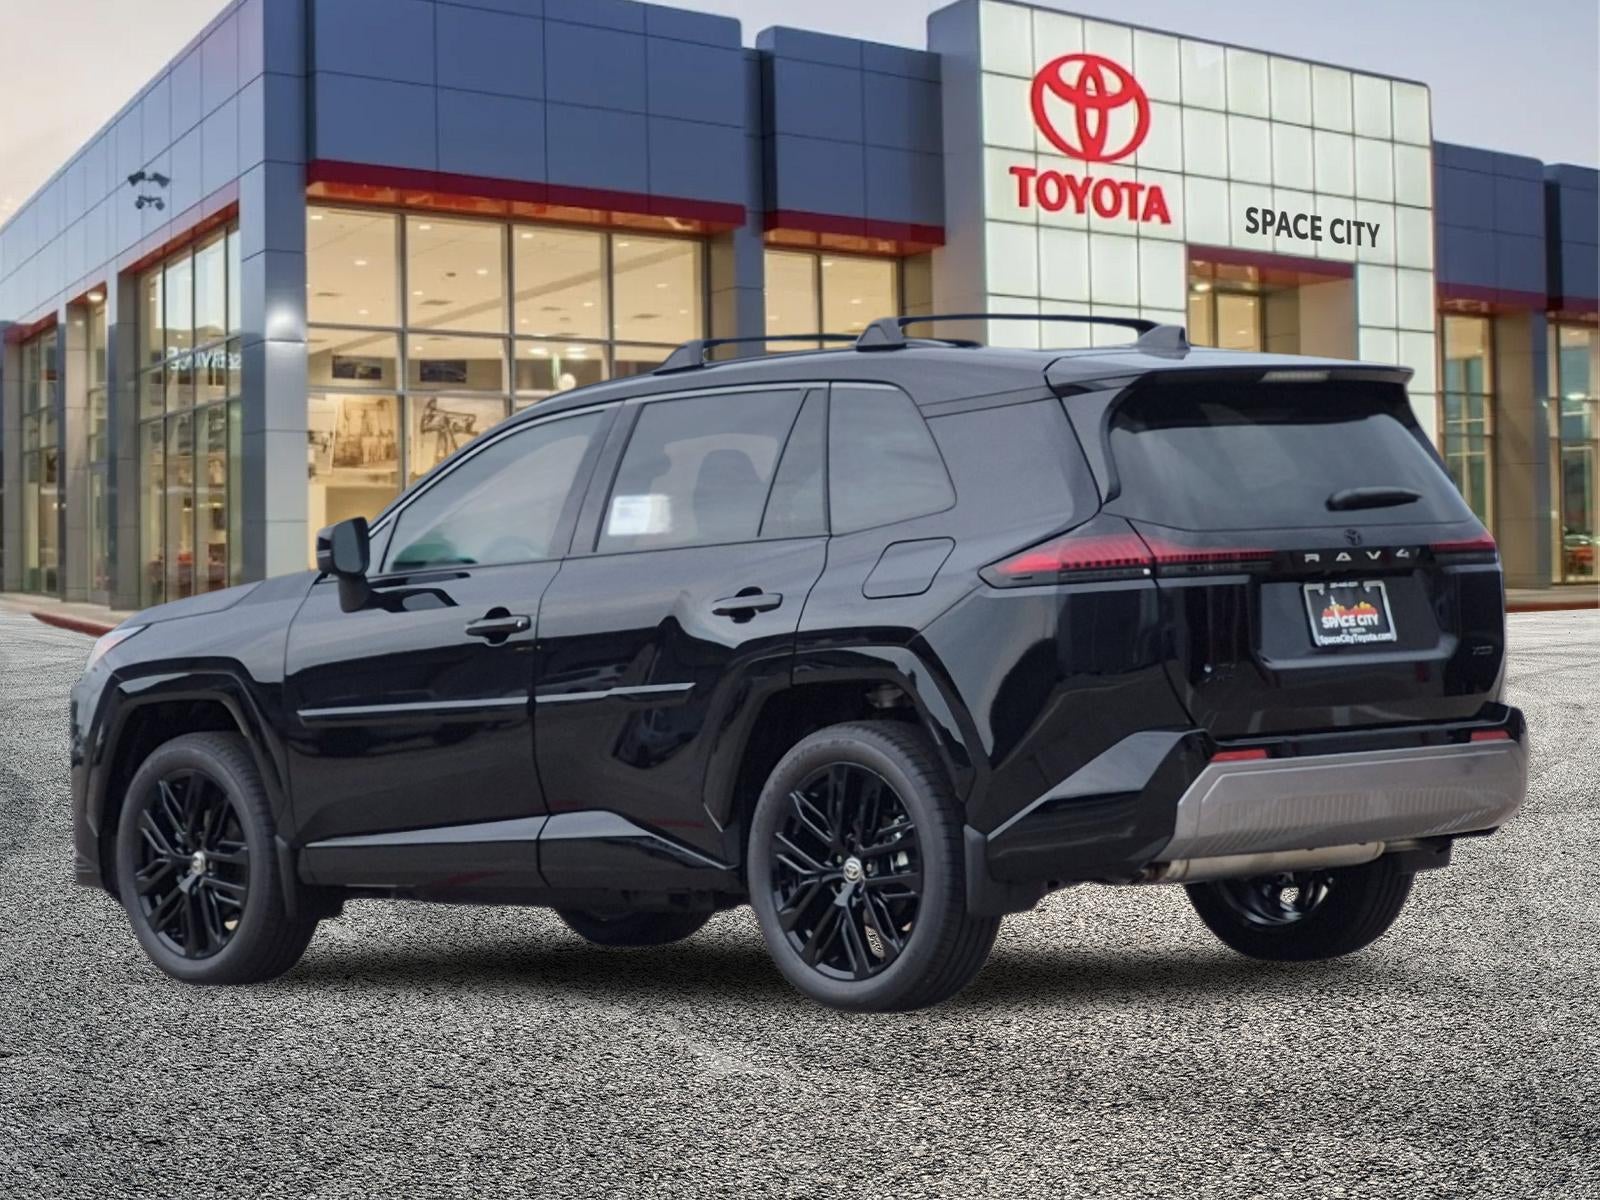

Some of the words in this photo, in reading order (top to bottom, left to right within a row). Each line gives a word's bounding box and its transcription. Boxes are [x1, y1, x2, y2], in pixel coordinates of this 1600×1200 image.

[1010, 167, 1170, 223] TOYOTA
[1246, 207, 1321, 241] SPACE
[1330, 219, 1380, 248] CITY
[1304, 549, 1409, 562] RAV4
[1321, 615, 1356, 628] SPACE
[1357, 614, 1378, 626] CITY
[1320, 633, 1392, 644] SpaceCityToyota.com
